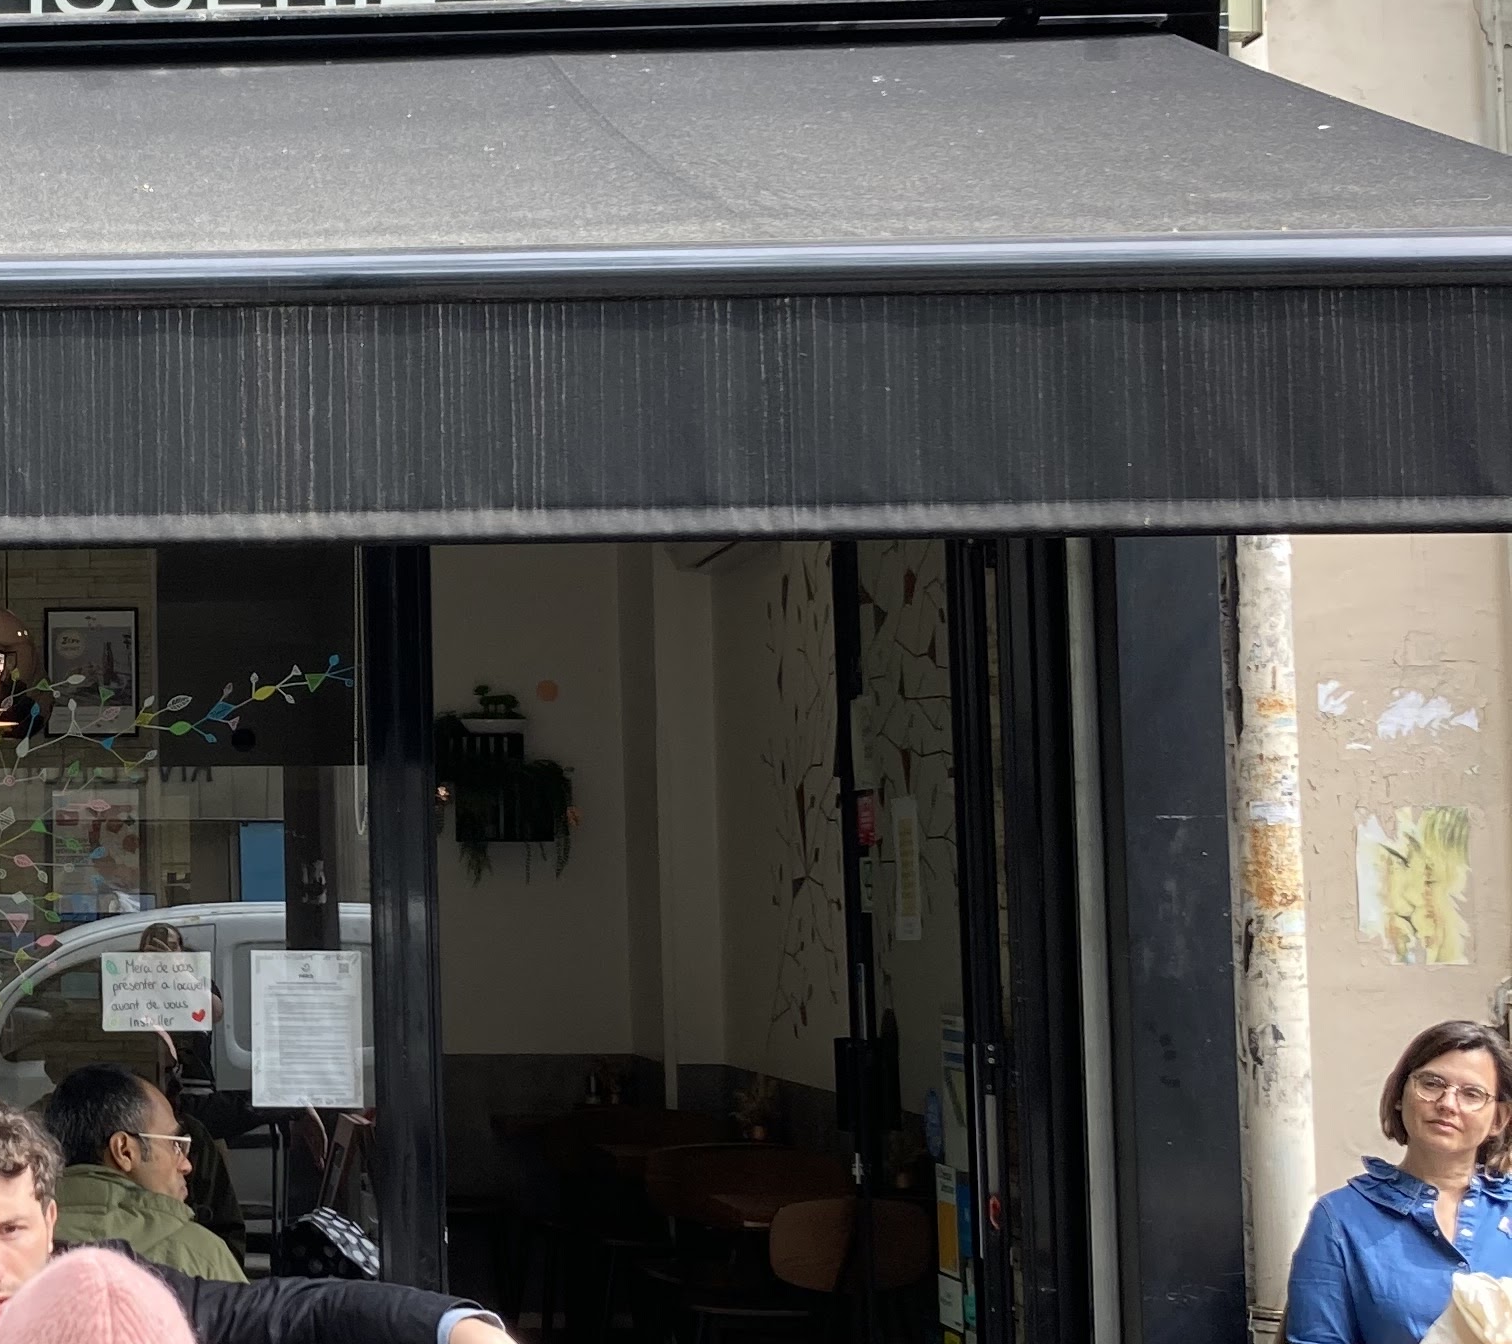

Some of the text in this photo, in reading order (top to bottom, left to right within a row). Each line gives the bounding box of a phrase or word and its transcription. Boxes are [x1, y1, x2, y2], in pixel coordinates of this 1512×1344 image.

[156, 960, 169, 974] de
[111, 999, 189, 1012] avant de vous
